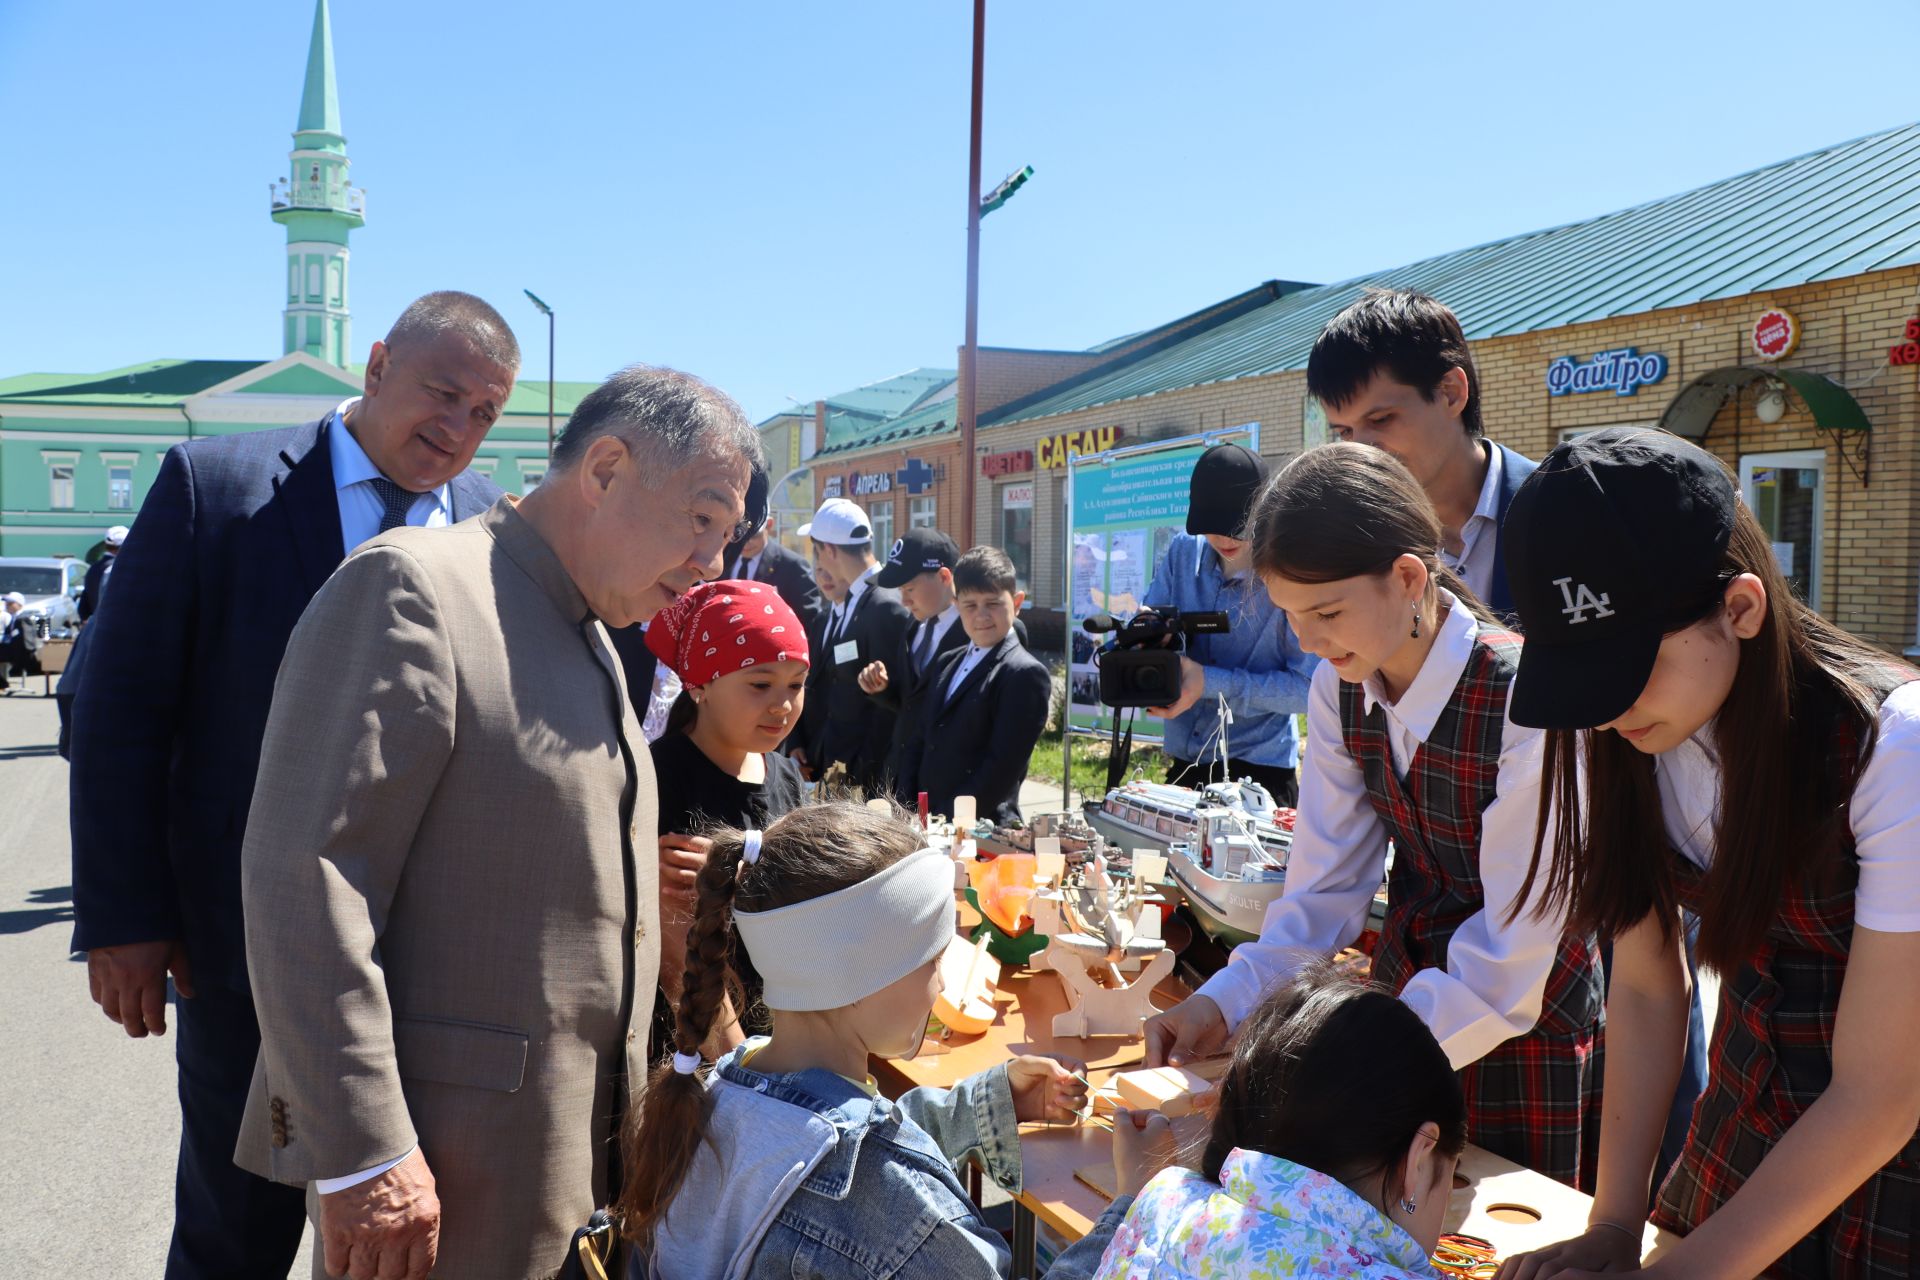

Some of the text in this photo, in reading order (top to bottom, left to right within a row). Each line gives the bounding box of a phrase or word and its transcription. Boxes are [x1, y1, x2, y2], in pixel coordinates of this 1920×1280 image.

[1547, 348, 1663, 396] ФайТро
[1037, 425, 1116, 470] САБАН
[981, 450, 1032, 480] ЦВЕТЫ
[855, 472, 891, 495] АПРЕЛЬ
[1127, 506, 1167, 520] Республики
[1552, 576, 1616, 625] LA
[1229, 893, 1261, 911] SKULTE
